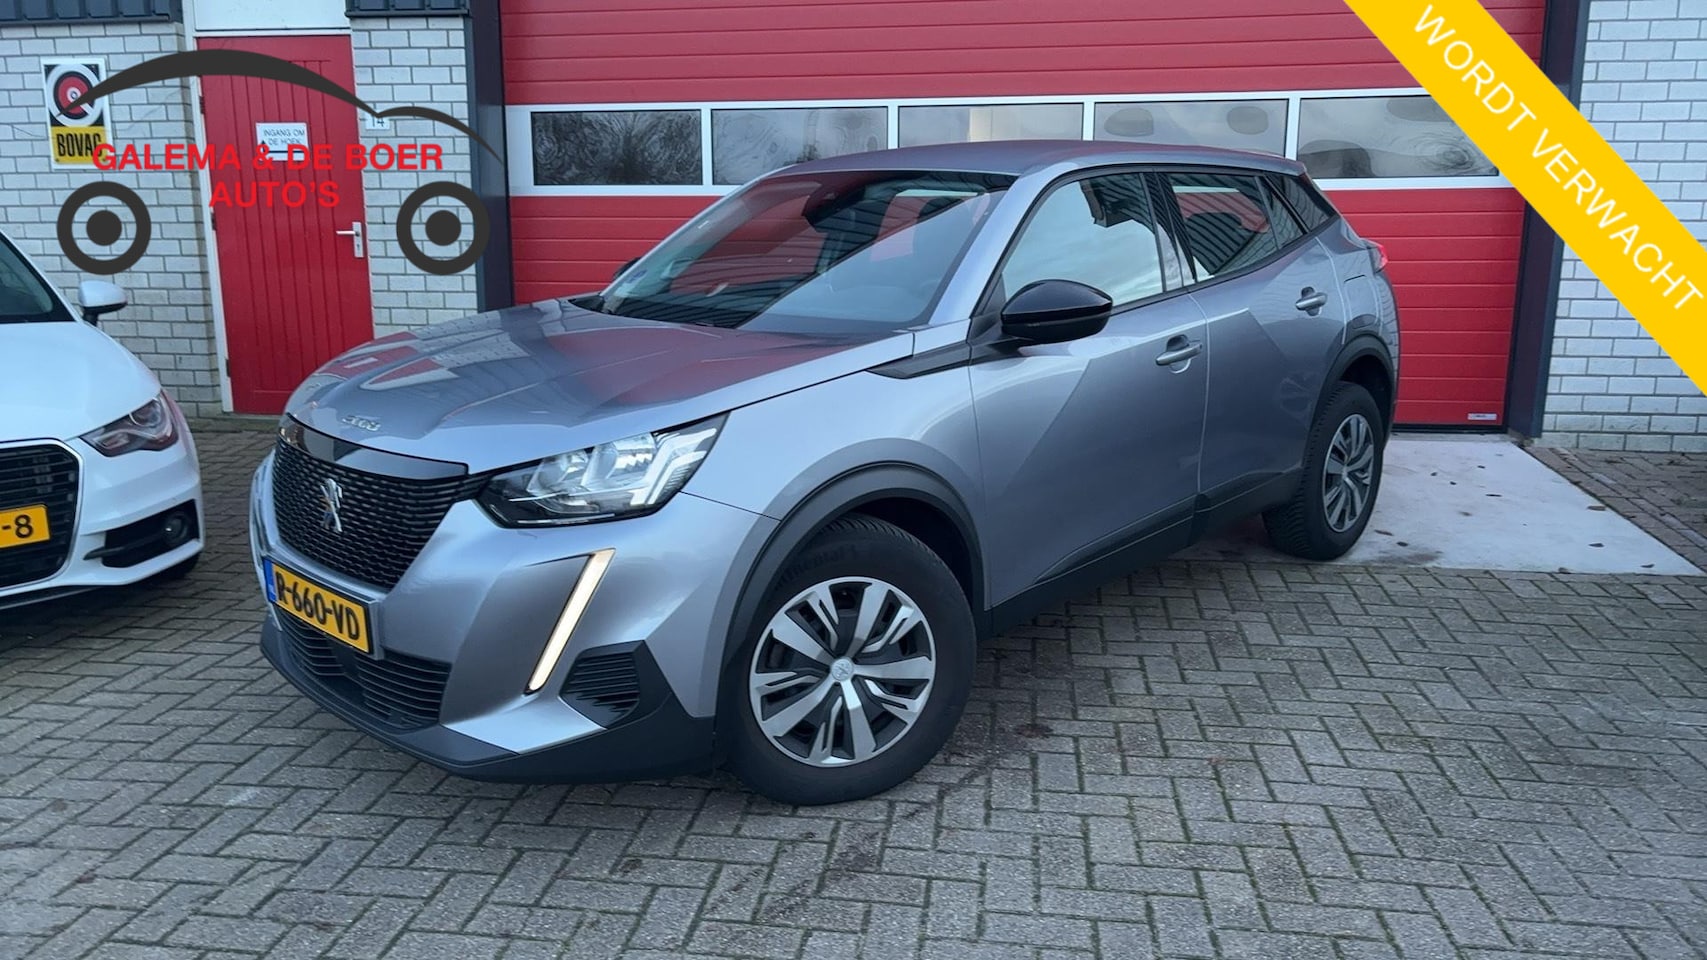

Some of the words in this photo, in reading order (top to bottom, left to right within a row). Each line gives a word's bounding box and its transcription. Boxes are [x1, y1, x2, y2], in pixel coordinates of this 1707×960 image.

[263, 128, 291, 137] INGANG
[292, 128, 305, 137] OM
[275, 571, 360, 640] R-660-VD
